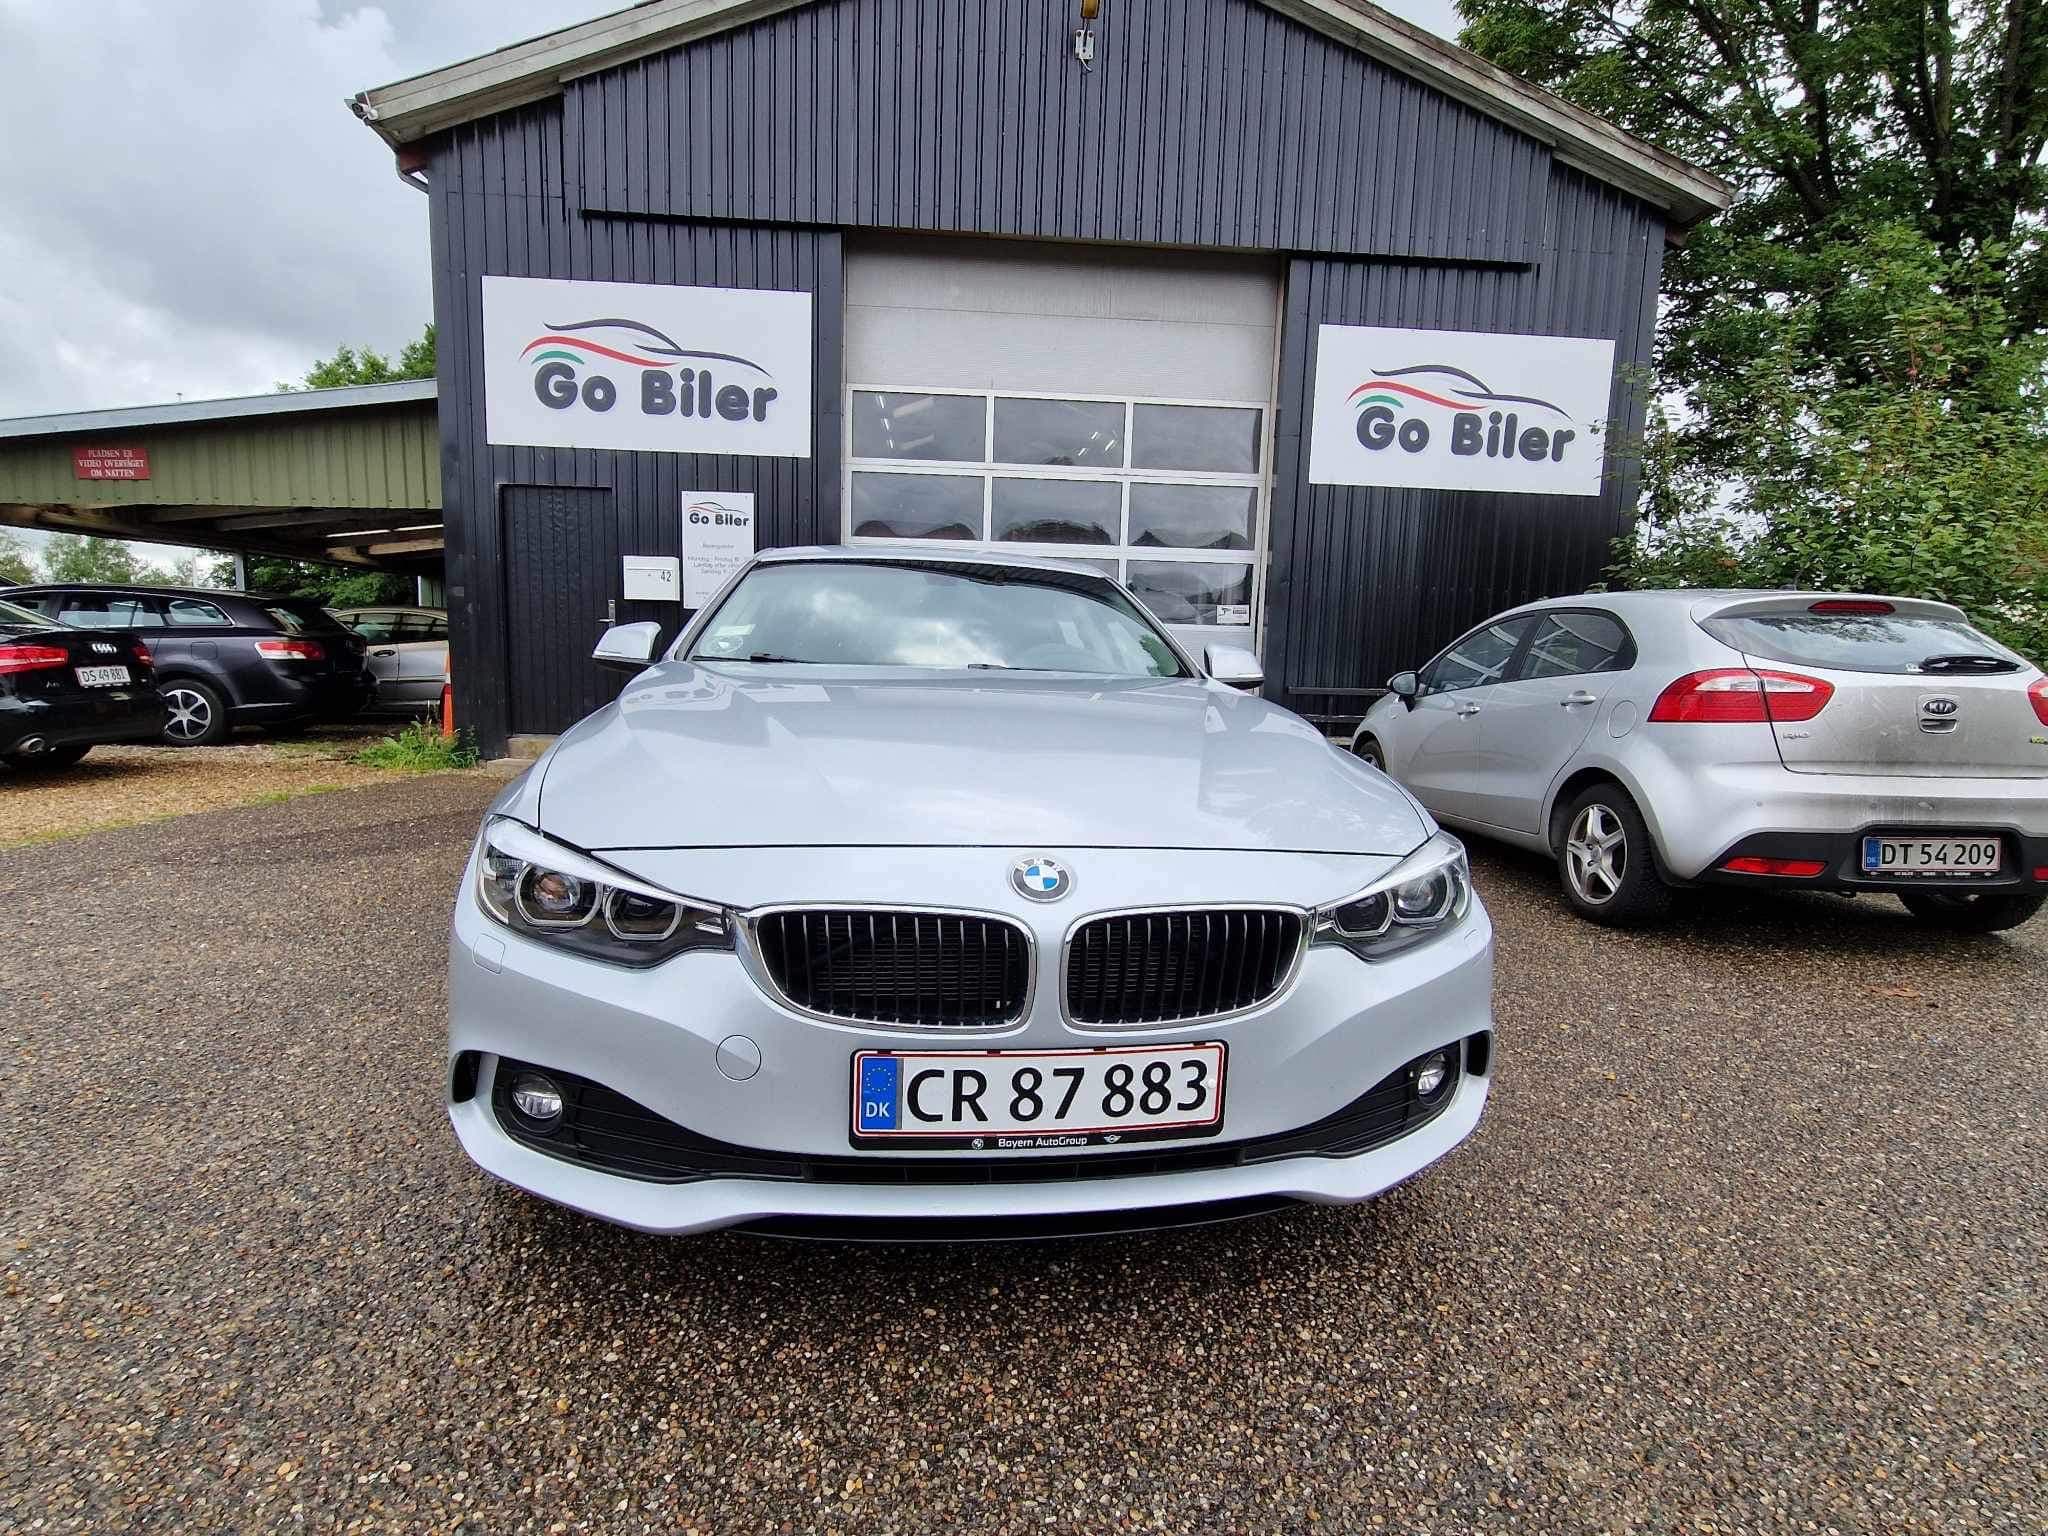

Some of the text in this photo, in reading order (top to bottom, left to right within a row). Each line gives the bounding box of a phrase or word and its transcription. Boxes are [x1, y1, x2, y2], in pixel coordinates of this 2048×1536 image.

[534, 361, 778, 422] Go Biler
[1356, 405, 1576, 462] Go Biler
[88, 449, 120, 458] PLADSEN
[79, 459, 102, 468] VIDEO
[90, 468, 135, 477] OM NATTEN
[689, 512, 750, 526] Go Biler
[660, 571, 673, 582] 42
[82, 668, 125, 682] DS 49 881
[1929, 702, 1953, 713] KIA
[1881, 843, 1996, 865] DT 54 209
[907, 1059, 1208, 1123] CR 87 883
[864, 1101, 891, 1118] DK
[998, 1136, 1088, 1149] Bayern AutoGroup
